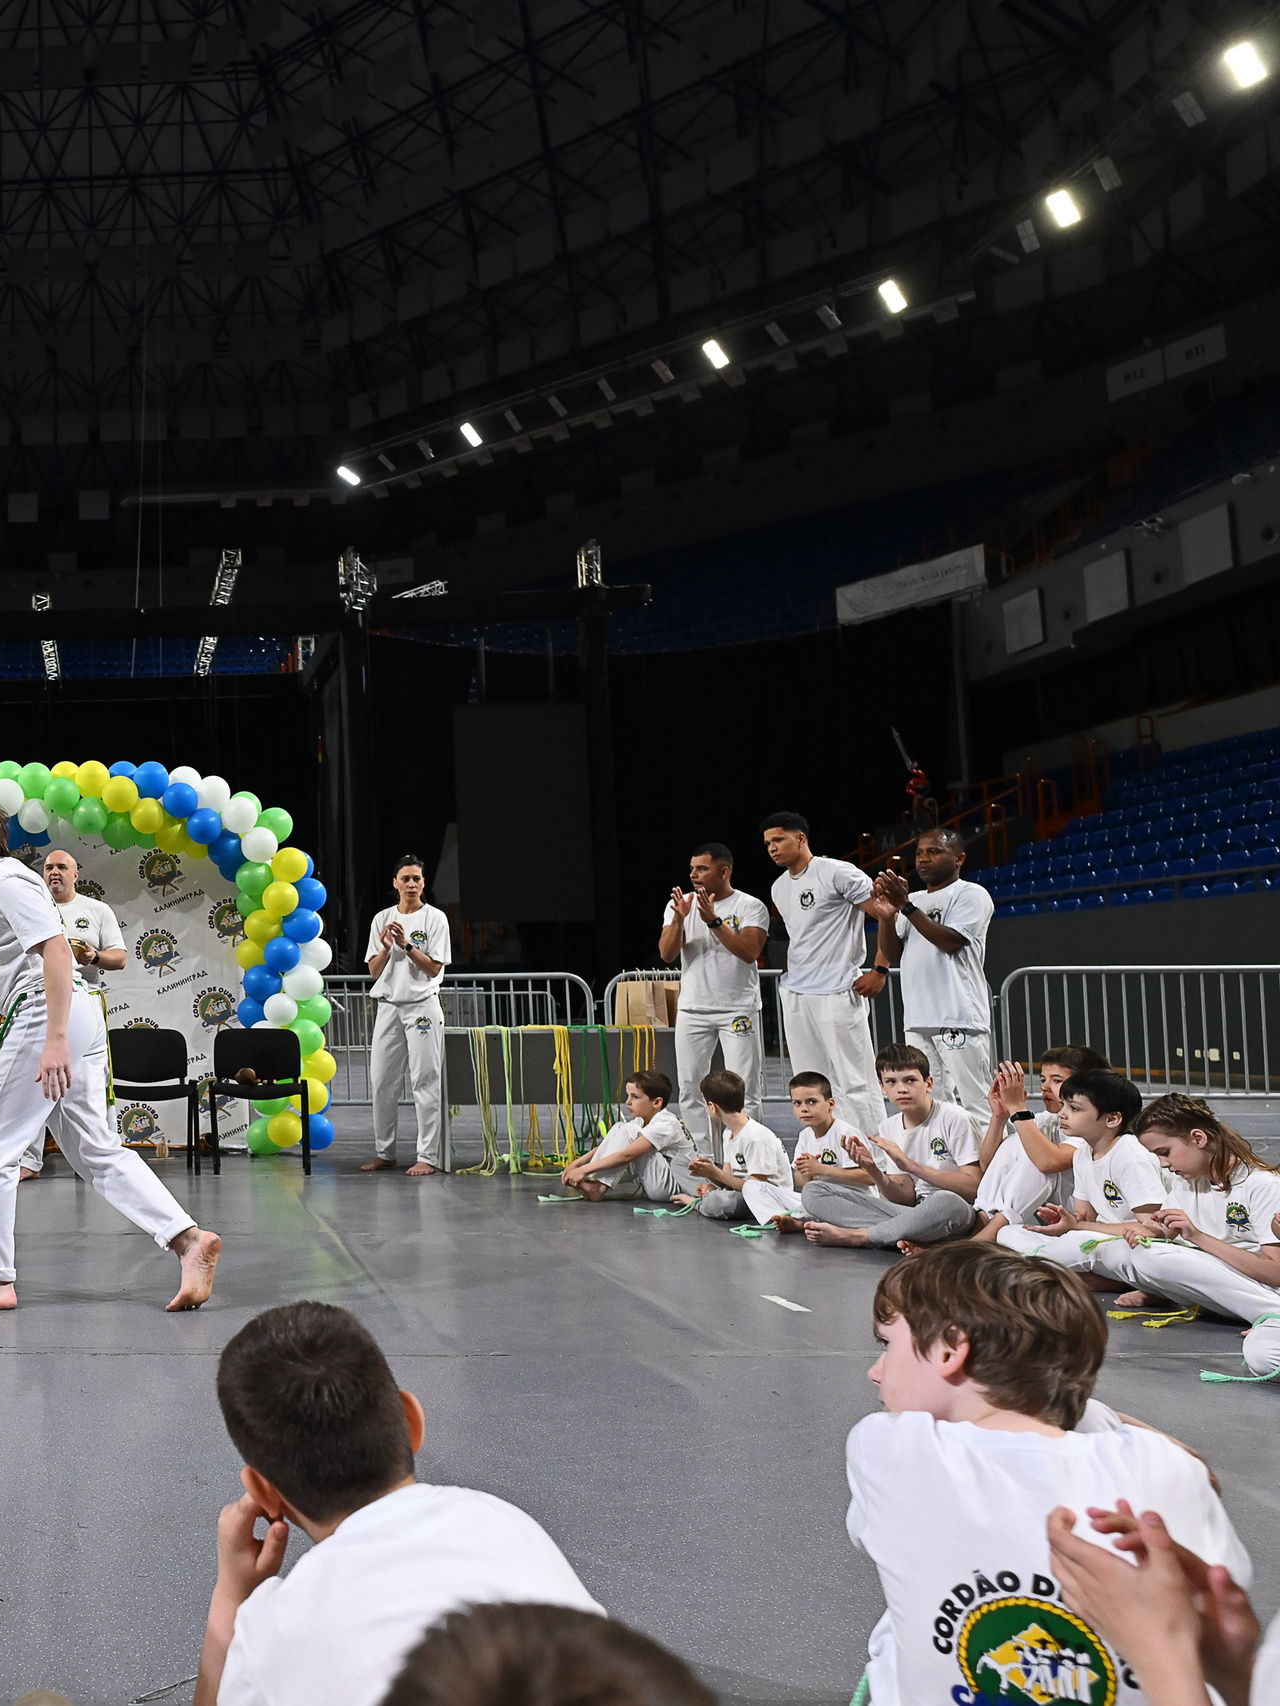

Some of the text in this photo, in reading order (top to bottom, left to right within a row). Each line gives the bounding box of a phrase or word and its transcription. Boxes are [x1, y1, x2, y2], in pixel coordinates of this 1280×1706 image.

[153, 889, 205, 914] КАЛИНИНГРАД
[160, 929, 178, 945] OURO
[156, 970, 208, 995] КАЛИНИНГРАД
[218, 987, 236, 1003] OURO
[141, 1103, 159, 1119] OURO
[218, 1123, 249, 1141] ЛИНИНГР
[932, 1569, 1021, 1656] CORDÃO
